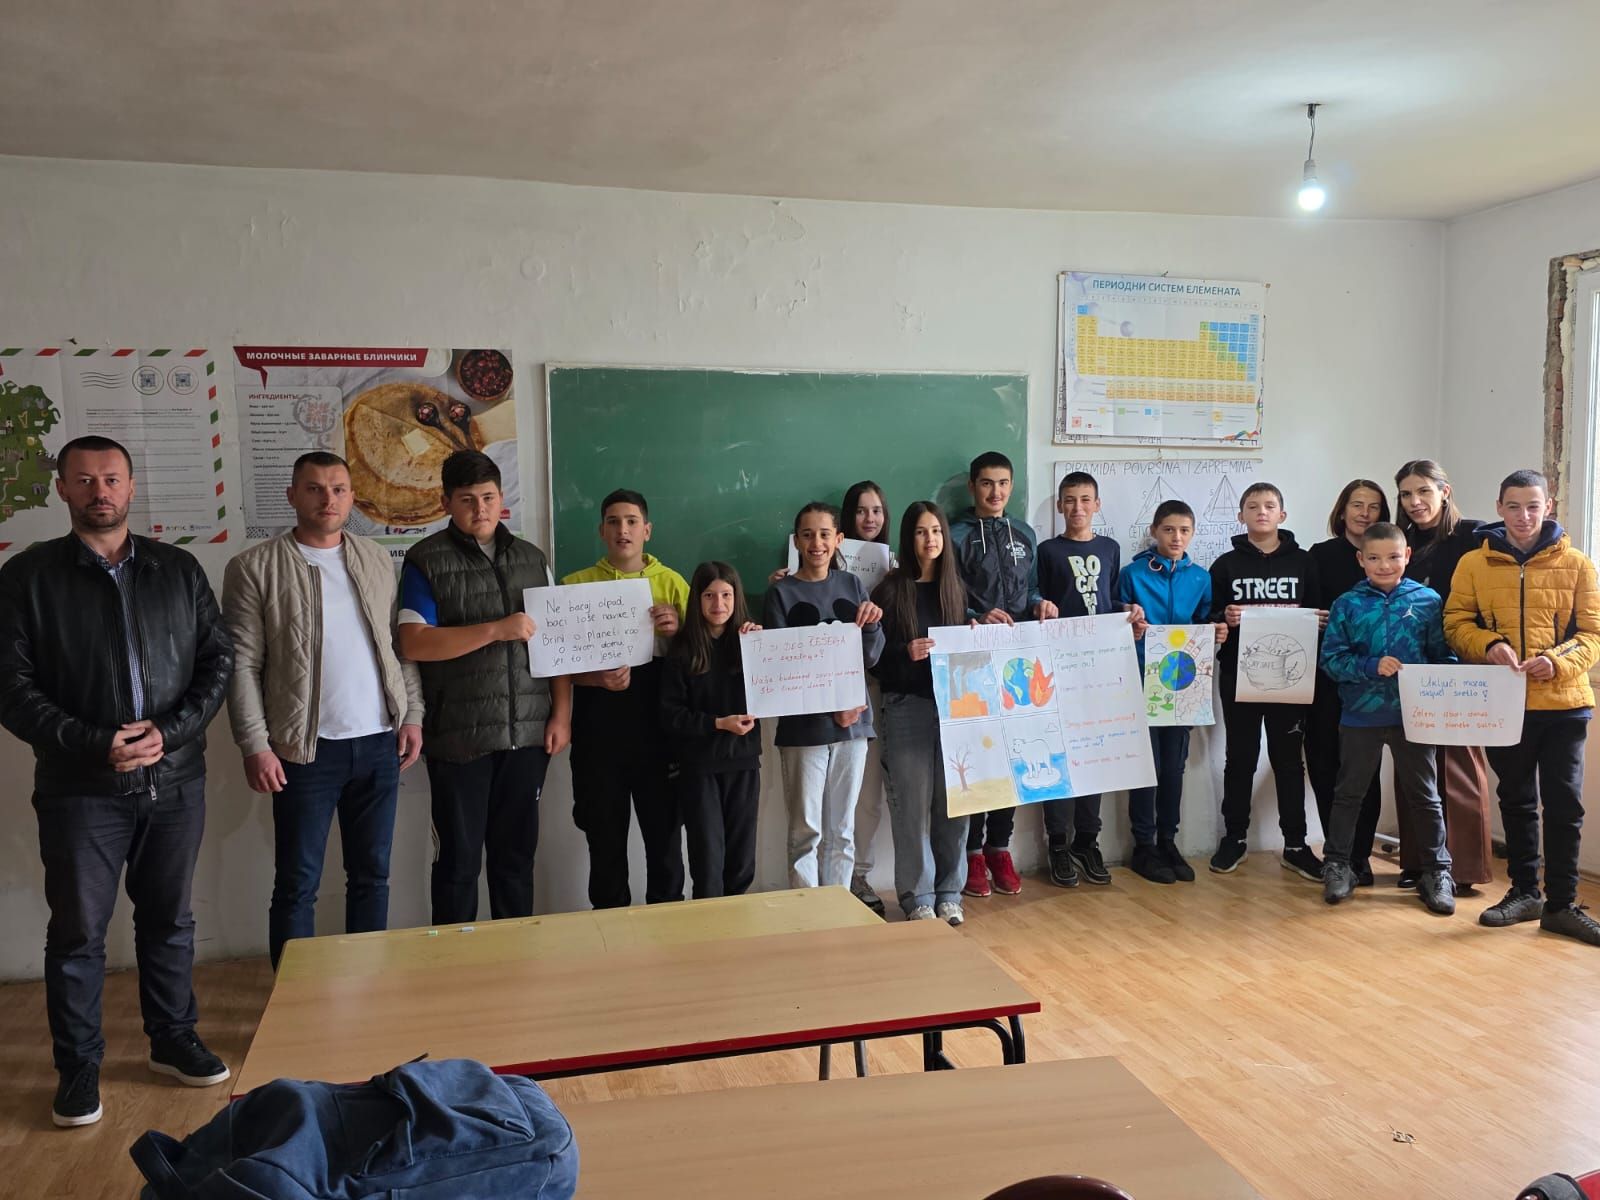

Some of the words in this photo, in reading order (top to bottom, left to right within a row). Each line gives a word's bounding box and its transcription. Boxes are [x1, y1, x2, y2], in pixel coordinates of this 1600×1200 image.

[1092, 279, 1146, 291] ПЕРИОДНИ
[1148, 282, 1184, 293] СИСТЕМ
[1186, 285, 1241, 297] ЕЛЕМЕНАТА
[246, 352, 306, 360] МОЛОЧНЫЕ
[308, 353, 362, 361] ЗАВАРНЫЕ
[363, 353, 417, 361] БЛИНЧИКИ
[1065, 462, 1117, 475] PIRAMIDA
[1231, 577, 1299, 600] STREET
[546, 600, 561, 614] Ne
[569, 600, 591, 613] bacaj
[546, 617, 568, 628] baci
